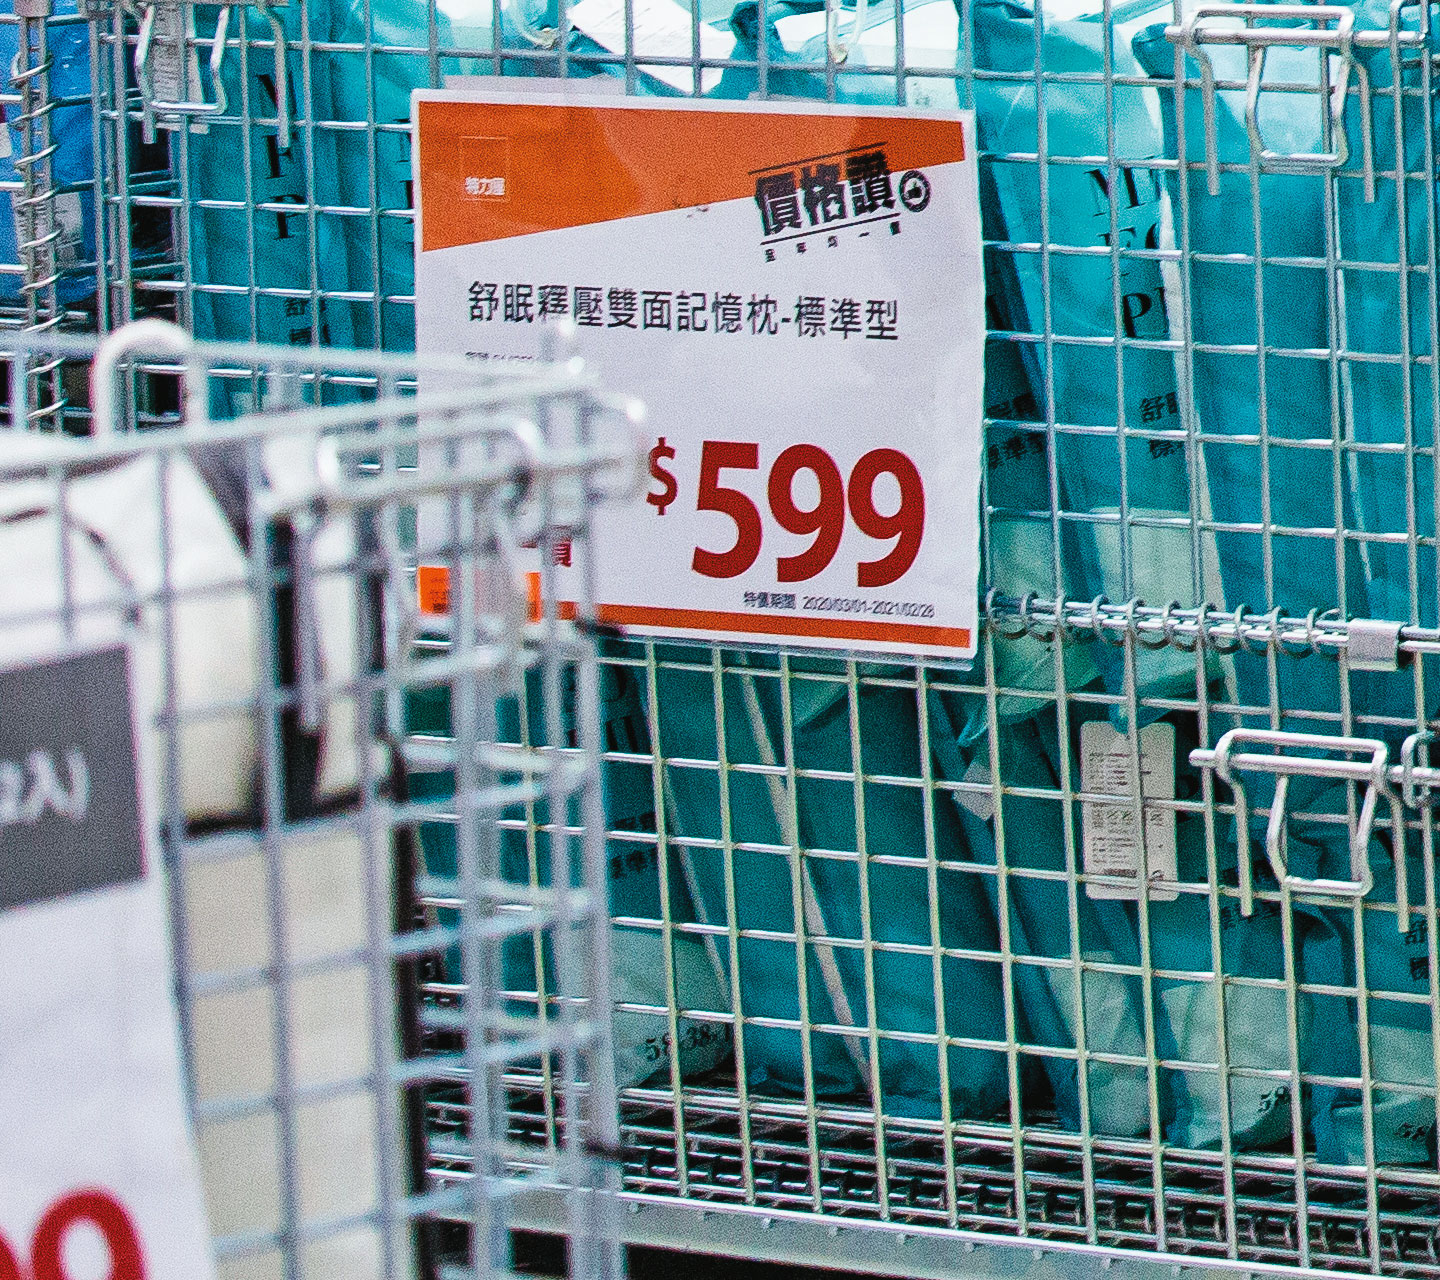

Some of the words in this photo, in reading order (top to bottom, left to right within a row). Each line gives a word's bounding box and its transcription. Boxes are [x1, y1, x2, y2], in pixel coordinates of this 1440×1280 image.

[753, 148, 897, 237] 價格讚
[467, 280, 899, 341] 舒眠釋壓雙面記憶枕-標準型
[645, 437, 926, 588] $599
